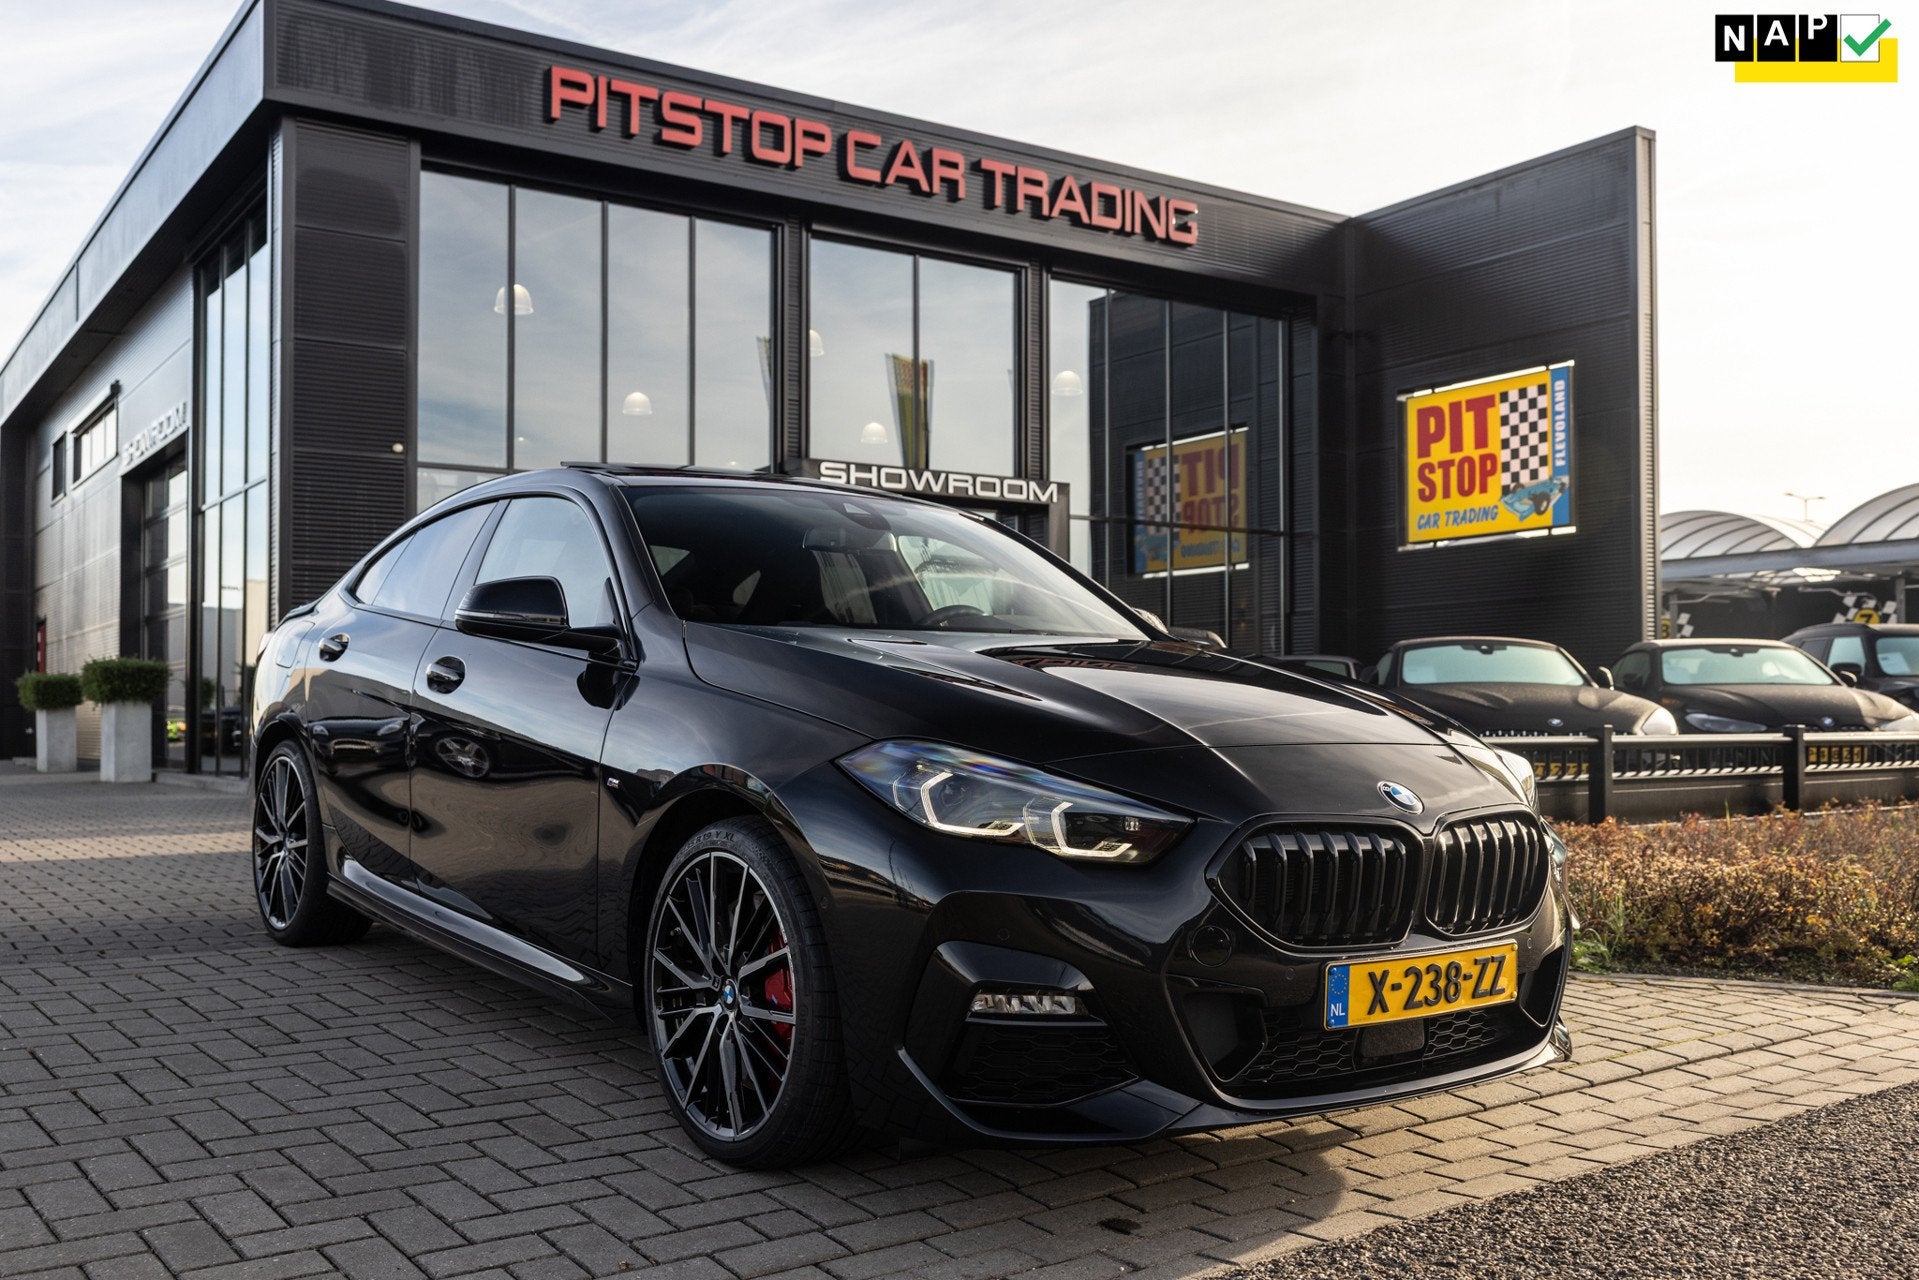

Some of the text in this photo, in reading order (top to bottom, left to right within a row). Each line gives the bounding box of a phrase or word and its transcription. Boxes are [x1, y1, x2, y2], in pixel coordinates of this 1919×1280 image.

[550, 65, 1198, 245] PITSTOP CAR TRADING
[1417, 394, 1496, 459] PIT
[1554, 379, 1566, 467] FLEVOLAND
[819, 461, 1058, 503] SHOWROOM
[1417, 453, 1498, 503] STOP
[1417, 505, 1499, 530] CAR TRADING
[1861, 613, 1873, 623] 7
[1330, 954, 1506, 1017] NL X-238-ZZ
